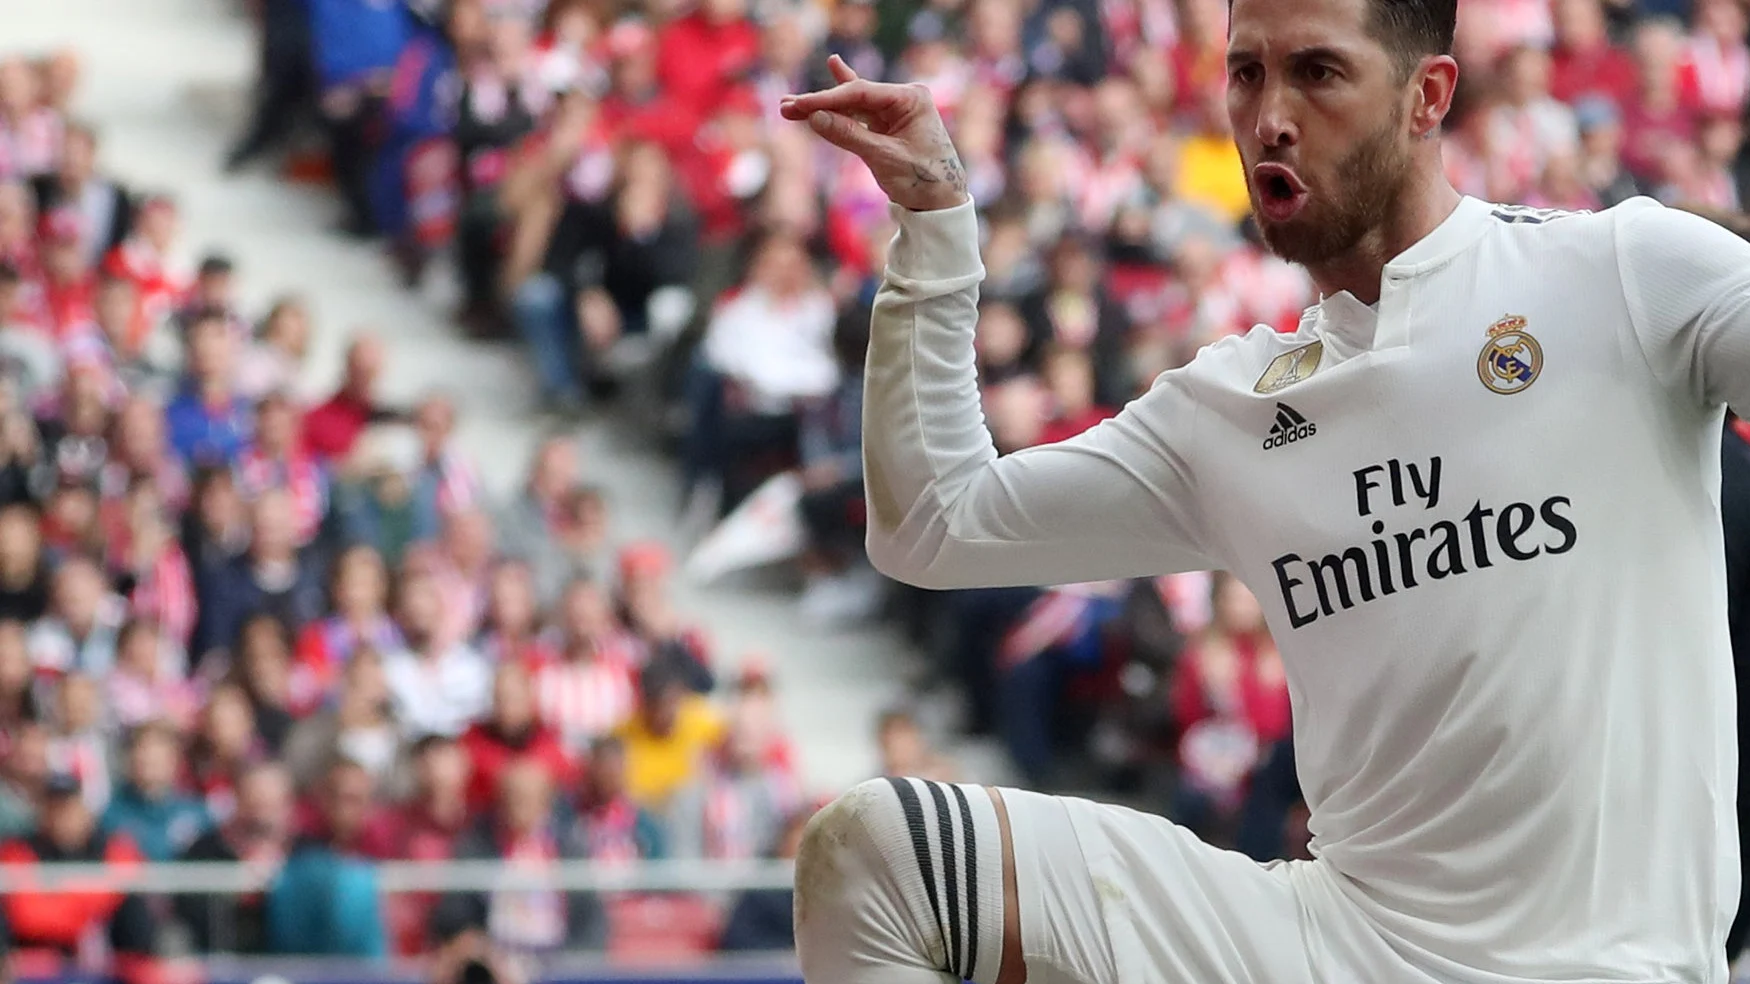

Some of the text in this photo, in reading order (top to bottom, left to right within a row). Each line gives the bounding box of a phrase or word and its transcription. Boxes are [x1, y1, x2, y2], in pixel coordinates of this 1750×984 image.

[1263, 423, 1317, 450] adidas
[1353, 456, 1442, 516] Fly
[1271, 495, 1577, 630] Emirates
